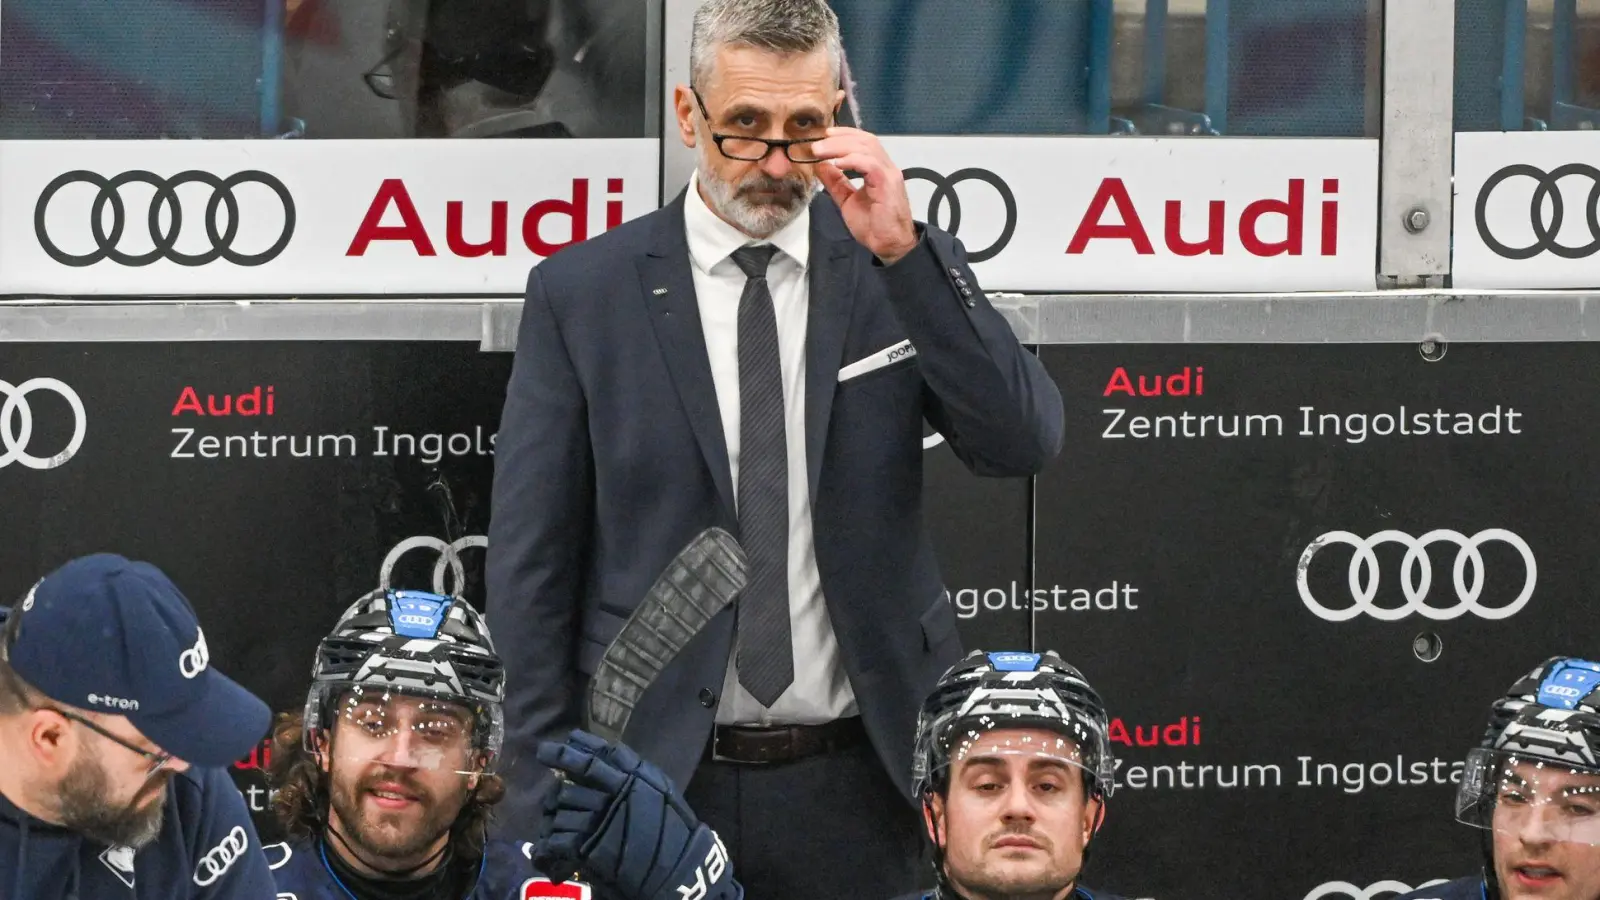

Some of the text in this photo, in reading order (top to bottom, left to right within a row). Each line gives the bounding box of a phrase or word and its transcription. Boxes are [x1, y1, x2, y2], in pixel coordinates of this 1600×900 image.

[345, 178, 624, 258] Audi
[1065, 177, 1339, 257] Audi
[1102, 366, 1204, 397] Audi
[171, 385, 275, 416] Audi
[1101, 405, 1522, 444] Zentrum Ingolstadt
[170, 427, 356, 458] Zentrum
[945, 580, 1139, 619] golstadt
[87, 692, 140, 711] e-tron
[1108, 715, 1202, 747] Audi
